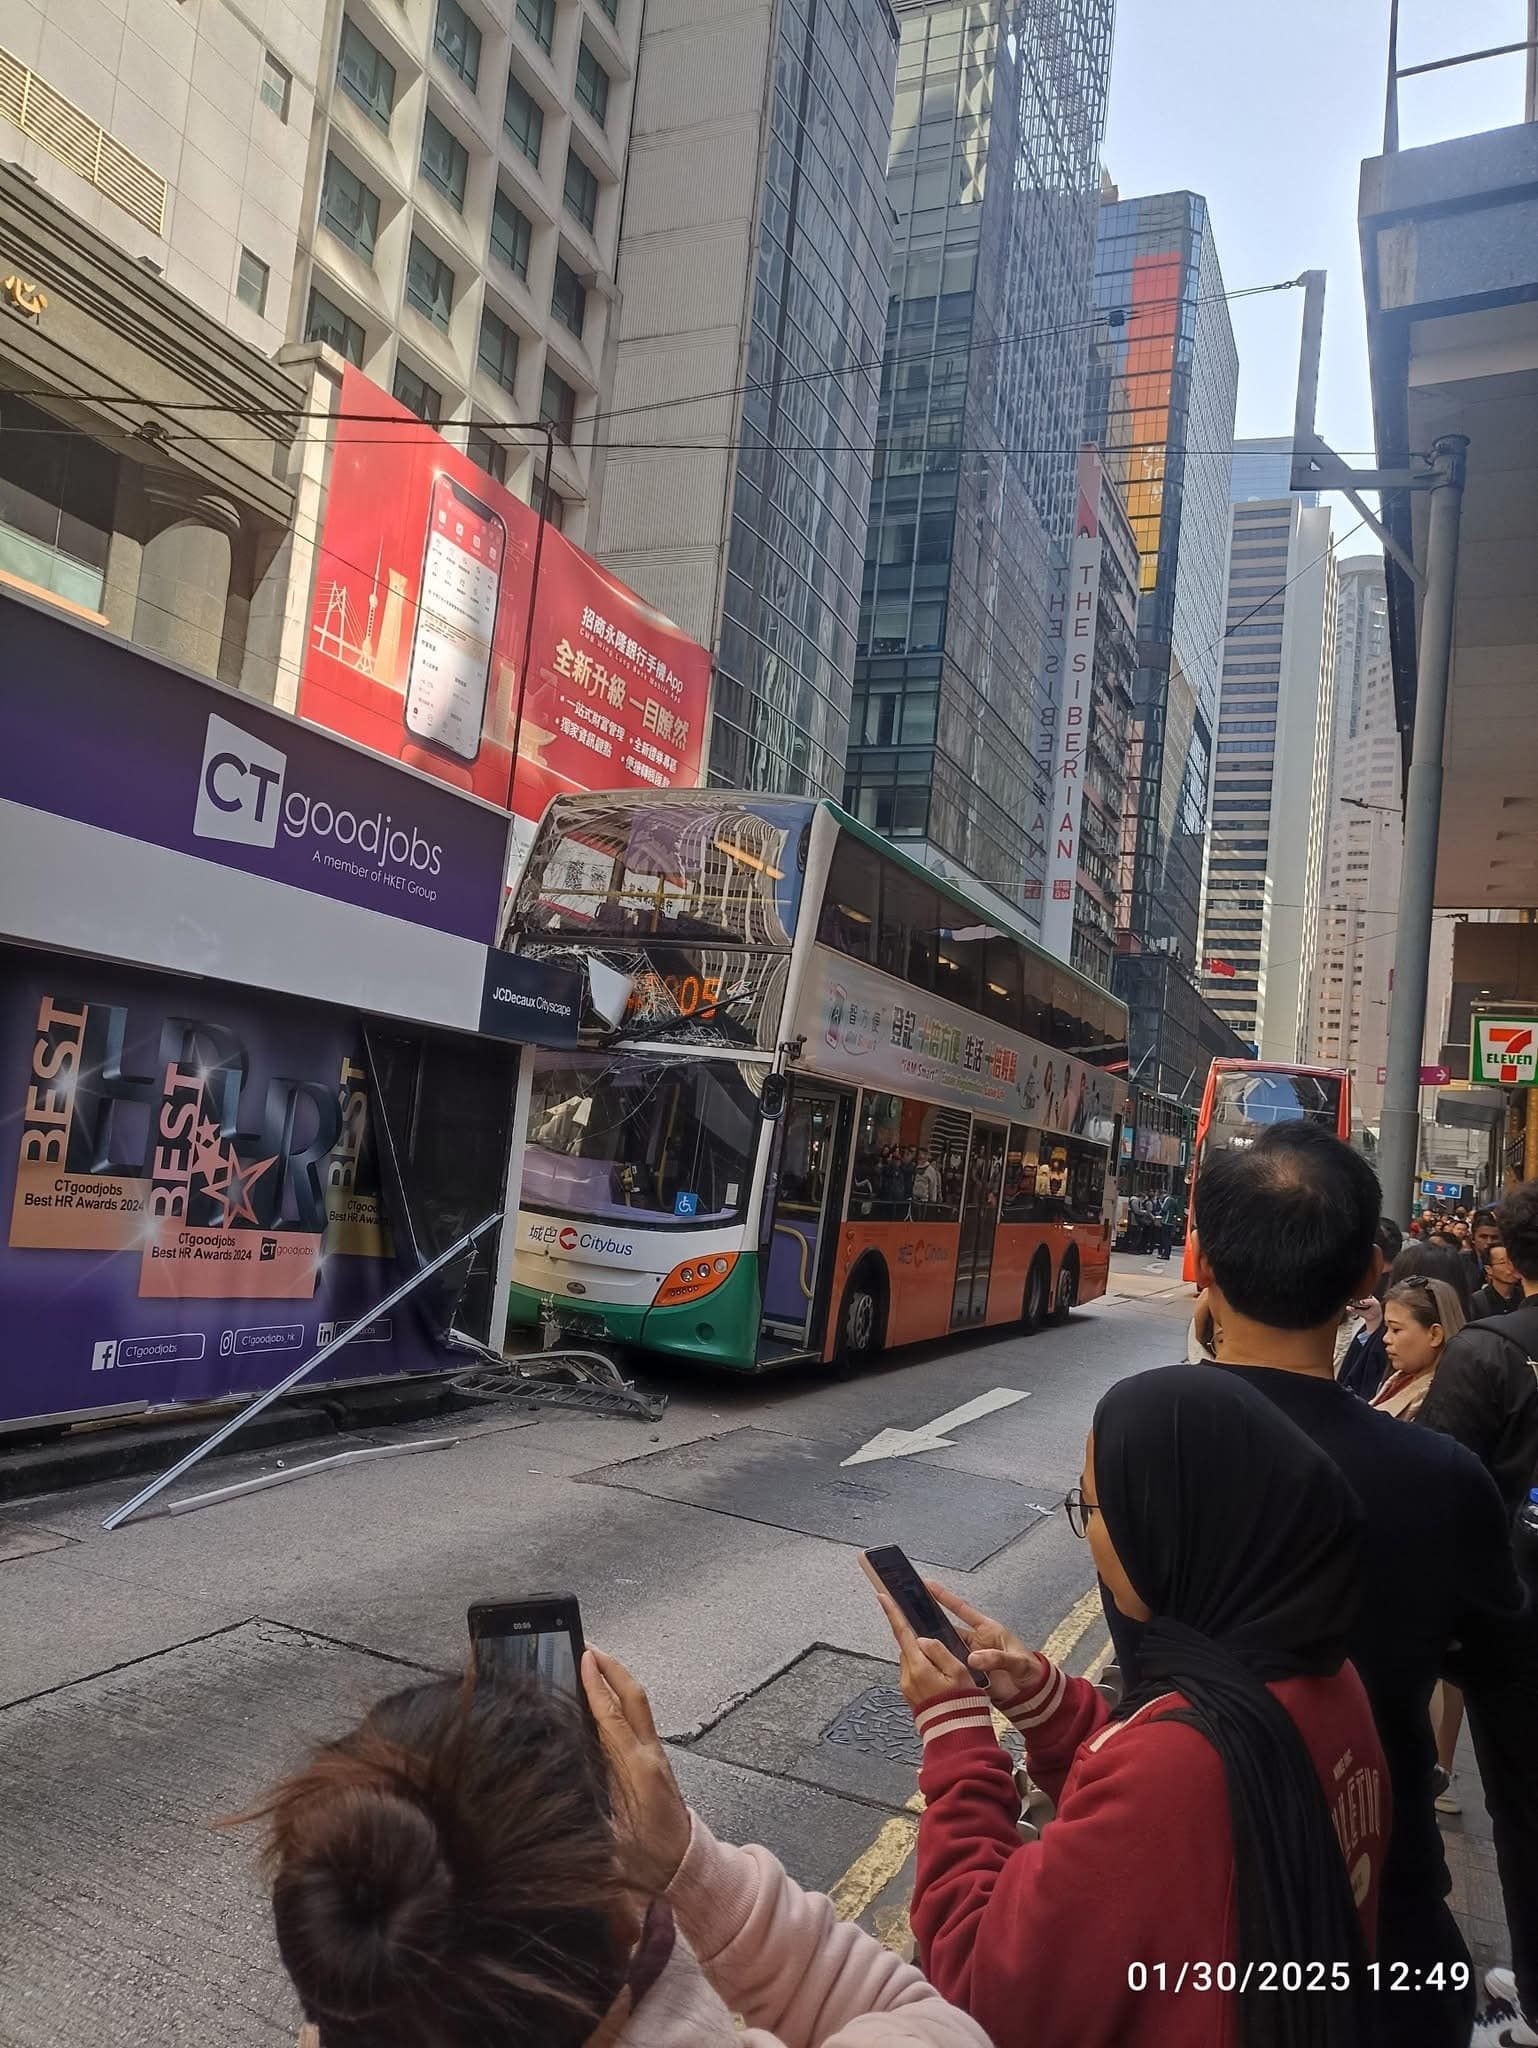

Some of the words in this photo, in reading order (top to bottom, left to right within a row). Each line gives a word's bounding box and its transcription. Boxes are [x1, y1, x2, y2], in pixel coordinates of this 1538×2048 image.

[1074, 564, 1094, 637] THE
[553, 639, 626, 711] 全新升級
[1057, 654, 1087, 859] SIBERIAN
[312, 850, 322, 861] A
[324, 855, 369, 879] member
[371, 870, 381, 882] of
[383, 873, 407, 891] HKET
[408, 882, 438, 901] Group
[492, 986, 537, 1012] JCDecaux
[537, 996, 572, 1017] Cityscape
[1489, 1028, 1532, 1081] 7
[22, 995, 88, 1165] BEST
[152, 1061, 205, 1218] BEST
[24, 1193, 52, 1206] Best
[55, 1196, 73, 1208] HR
[76, 1197, 118, 1210] Awards
[54, 1179, 123, 1197] CTgoodjobs
[178, 1232, 236, 1249] CTgoodjobs
[529, 1224, 558, 1244] 城巴
[580, 1234, 633, 1256] Citybus
[151, 1246, 177, 1259] Best
[178, 1247, 192, 1259] HR
[193, 1248, 232, 1261] Awards
[232, 1249, 252, 1261] 2024
[125, 1344, 178, 1359] CTgoodjobs
